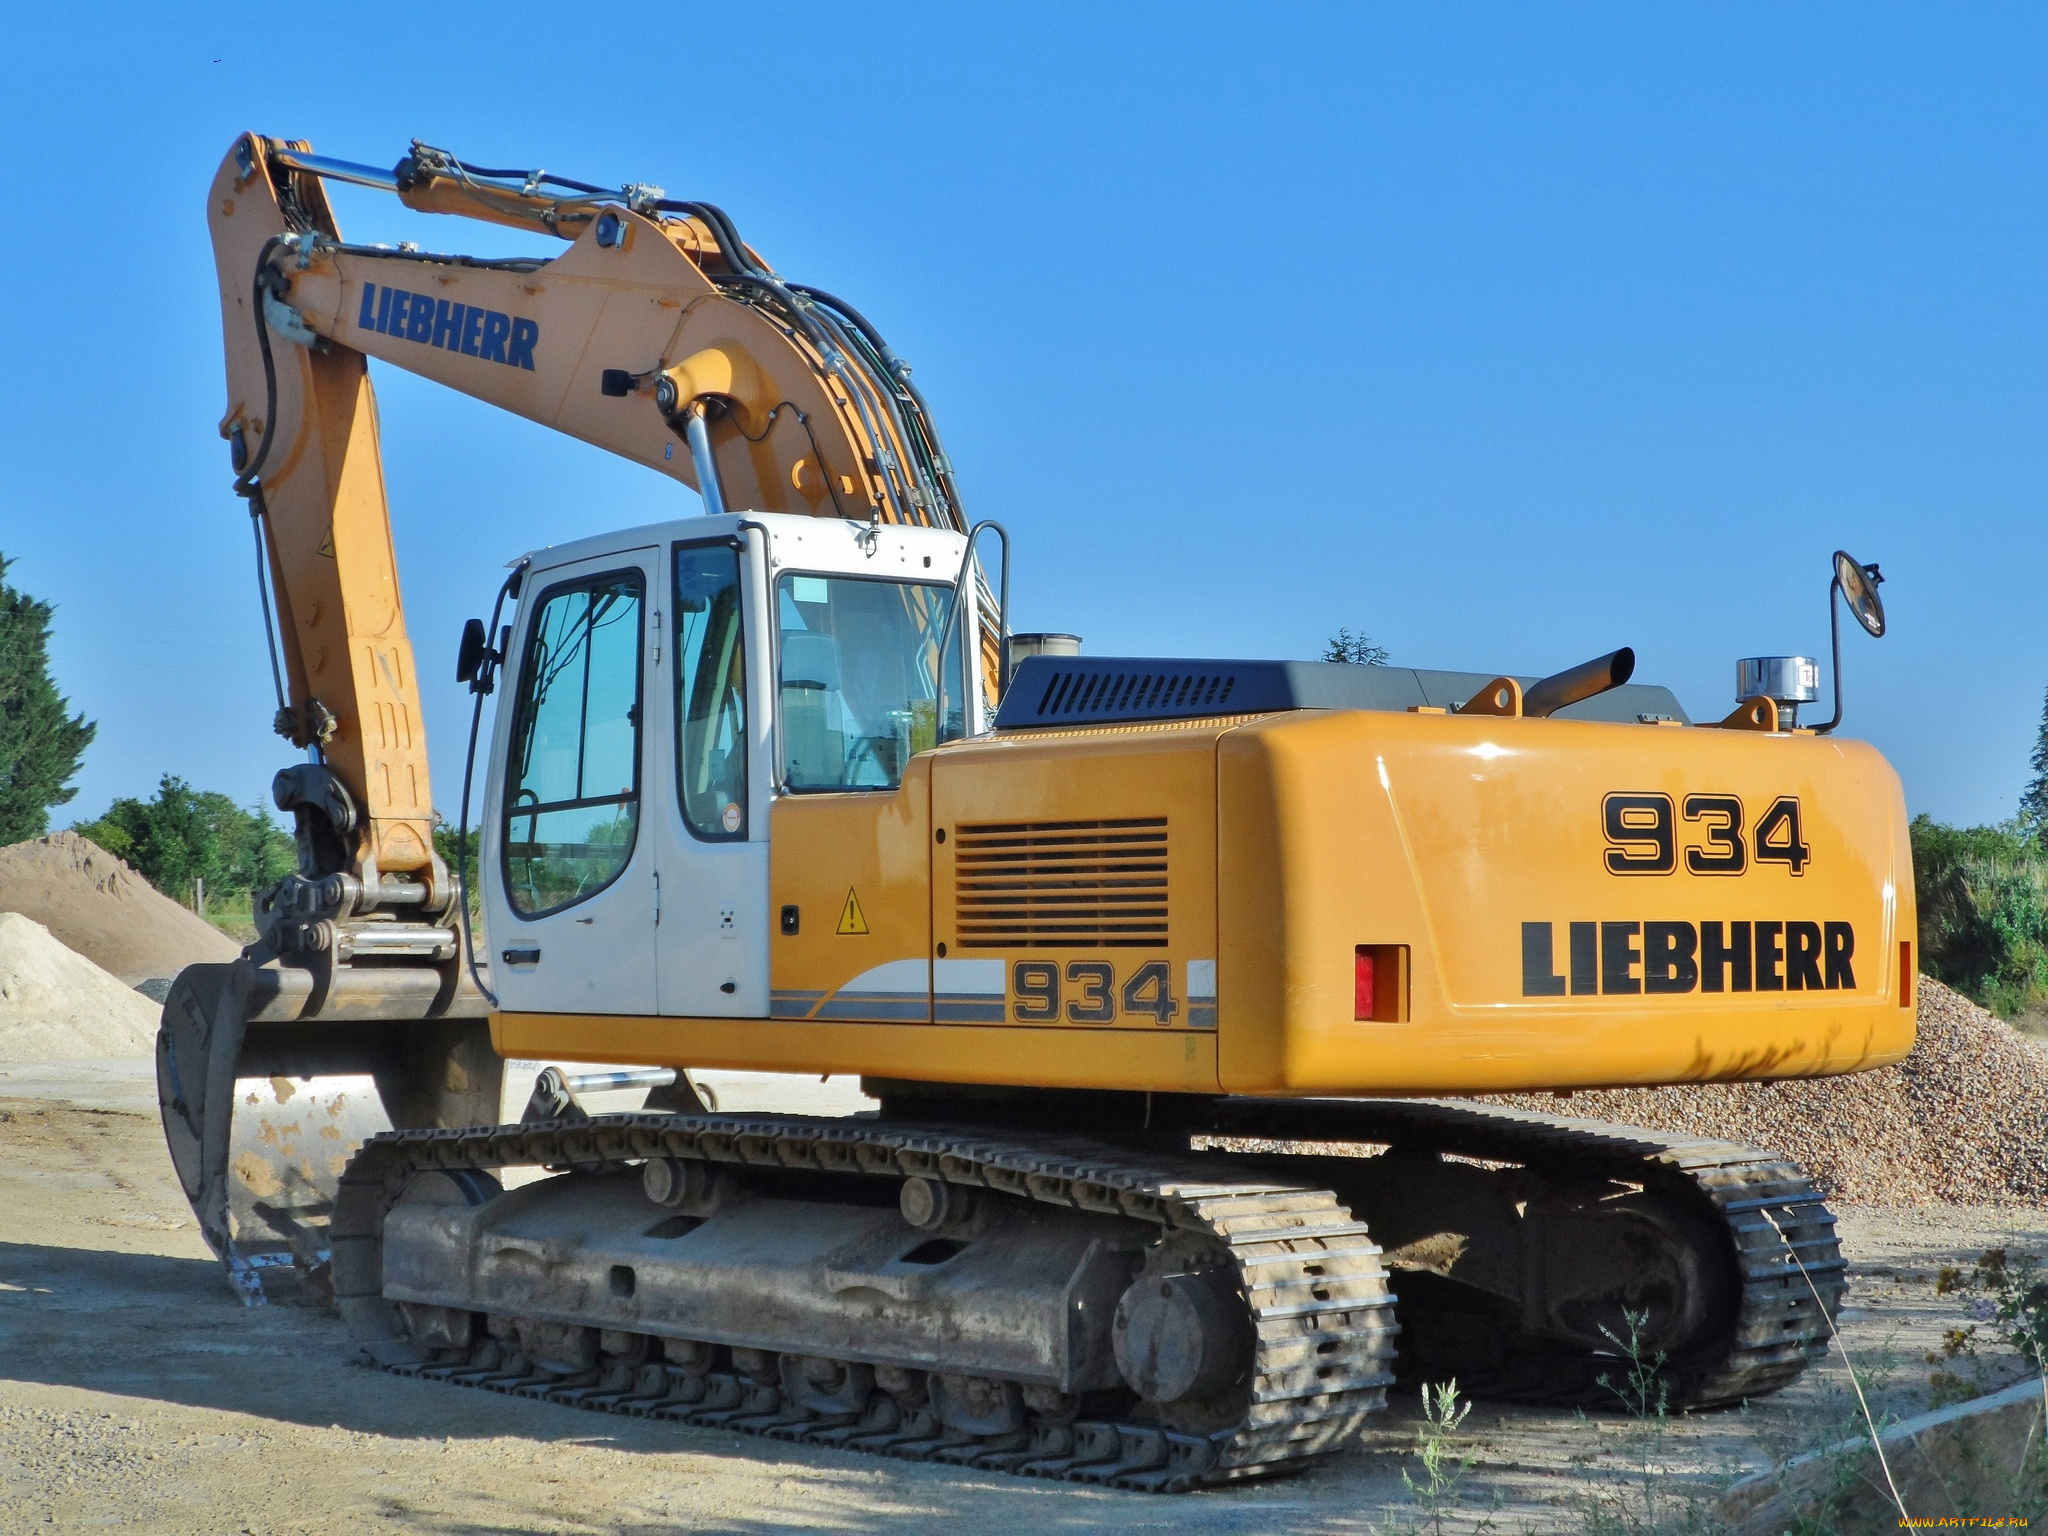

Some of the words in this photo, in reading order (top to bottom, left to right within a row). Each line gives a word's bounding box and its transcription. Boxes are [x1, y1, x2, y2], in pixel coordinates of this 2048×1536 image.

[358, 282, 539, 371] LIEBHERR
[1601, 791, 1811, 877] 934
[1013, 960, 1179, 1025] 934
[1521, 921, 1857, 997] LIEBHERR
